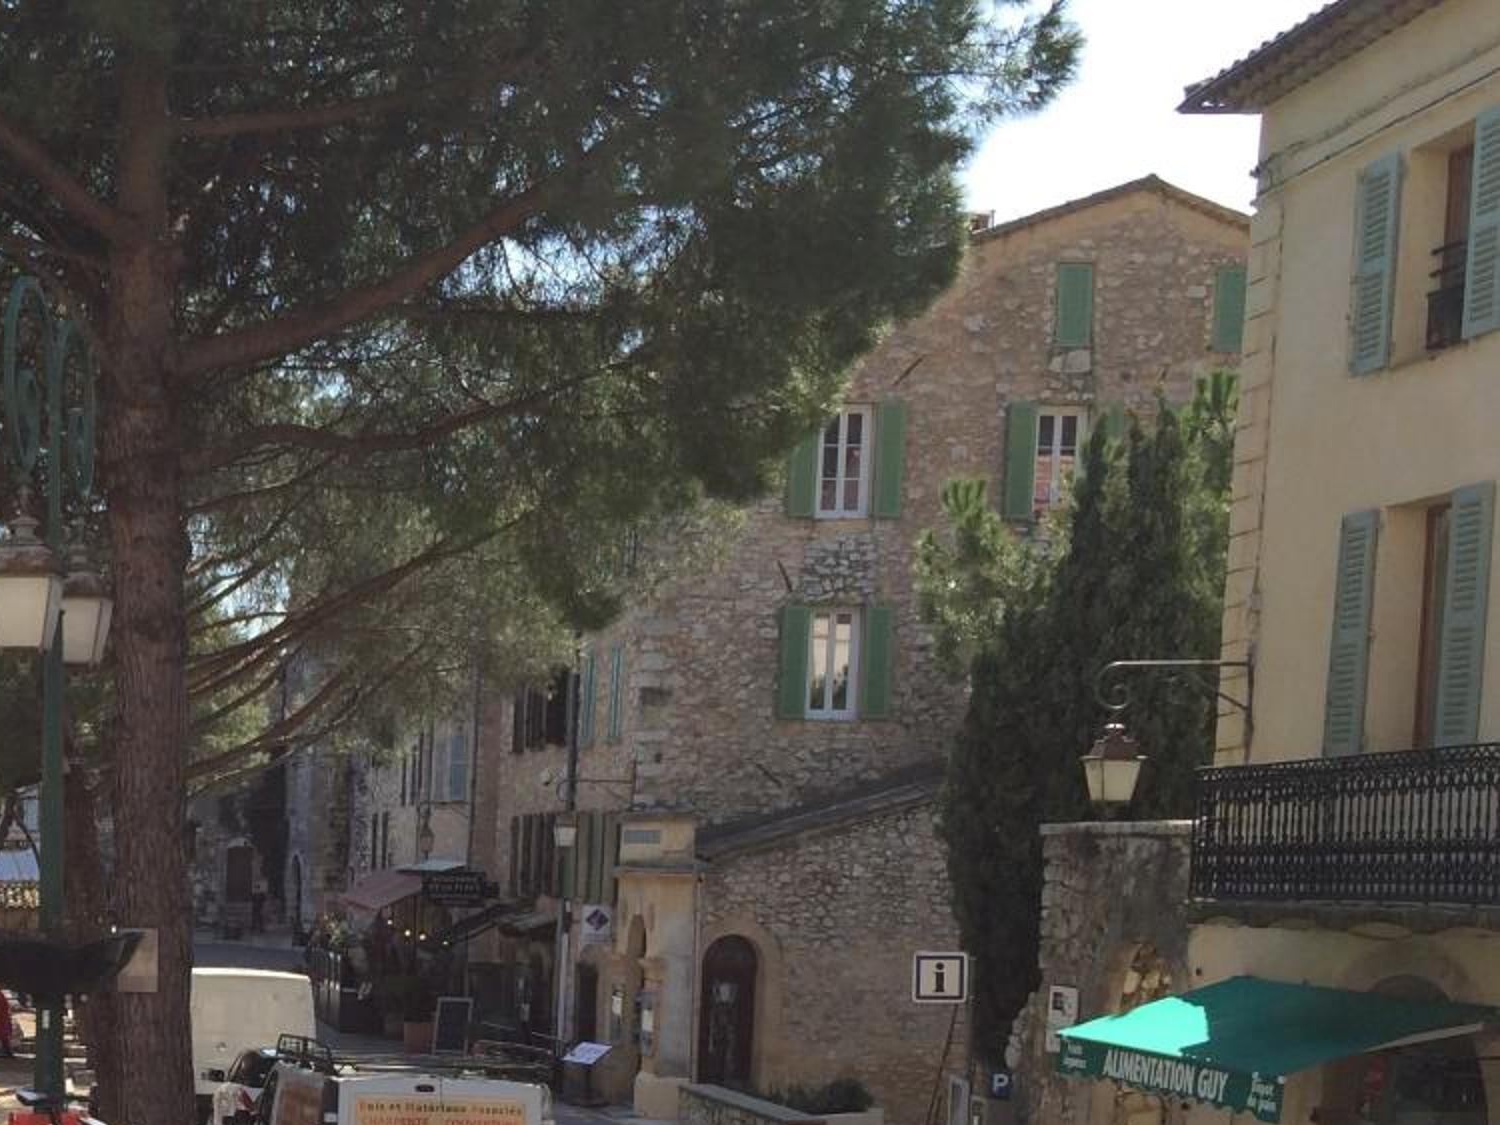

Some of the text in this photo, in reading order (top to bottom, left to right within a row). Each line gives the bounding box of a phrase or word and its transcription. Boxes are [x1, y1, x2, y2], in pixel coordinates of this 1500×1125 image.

[993, 1074, 1008, 1091] P
[1102, 1049, 1230, 1102] ALIMENTATION GUY
